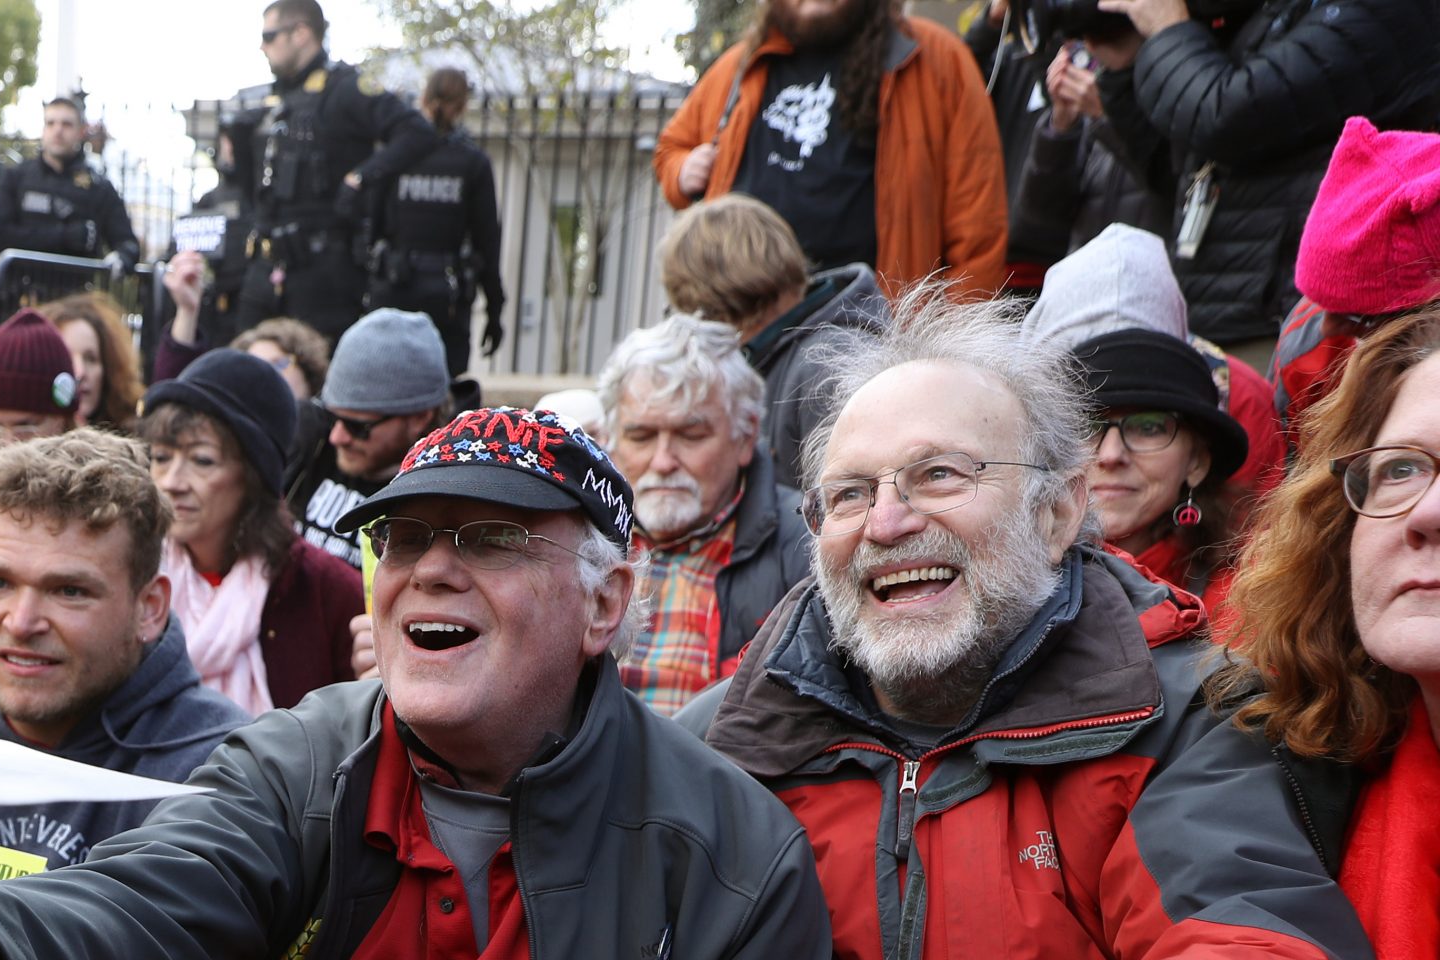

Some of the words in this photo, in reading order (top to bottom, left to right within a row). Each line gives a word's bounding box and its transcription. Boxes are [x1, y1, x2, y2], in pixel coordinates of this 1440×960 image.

[398, 173, 463, 203] POLICE
[1019, 844, 1056, 864] NORT
[1034, 856, 1060, 871] FAC
